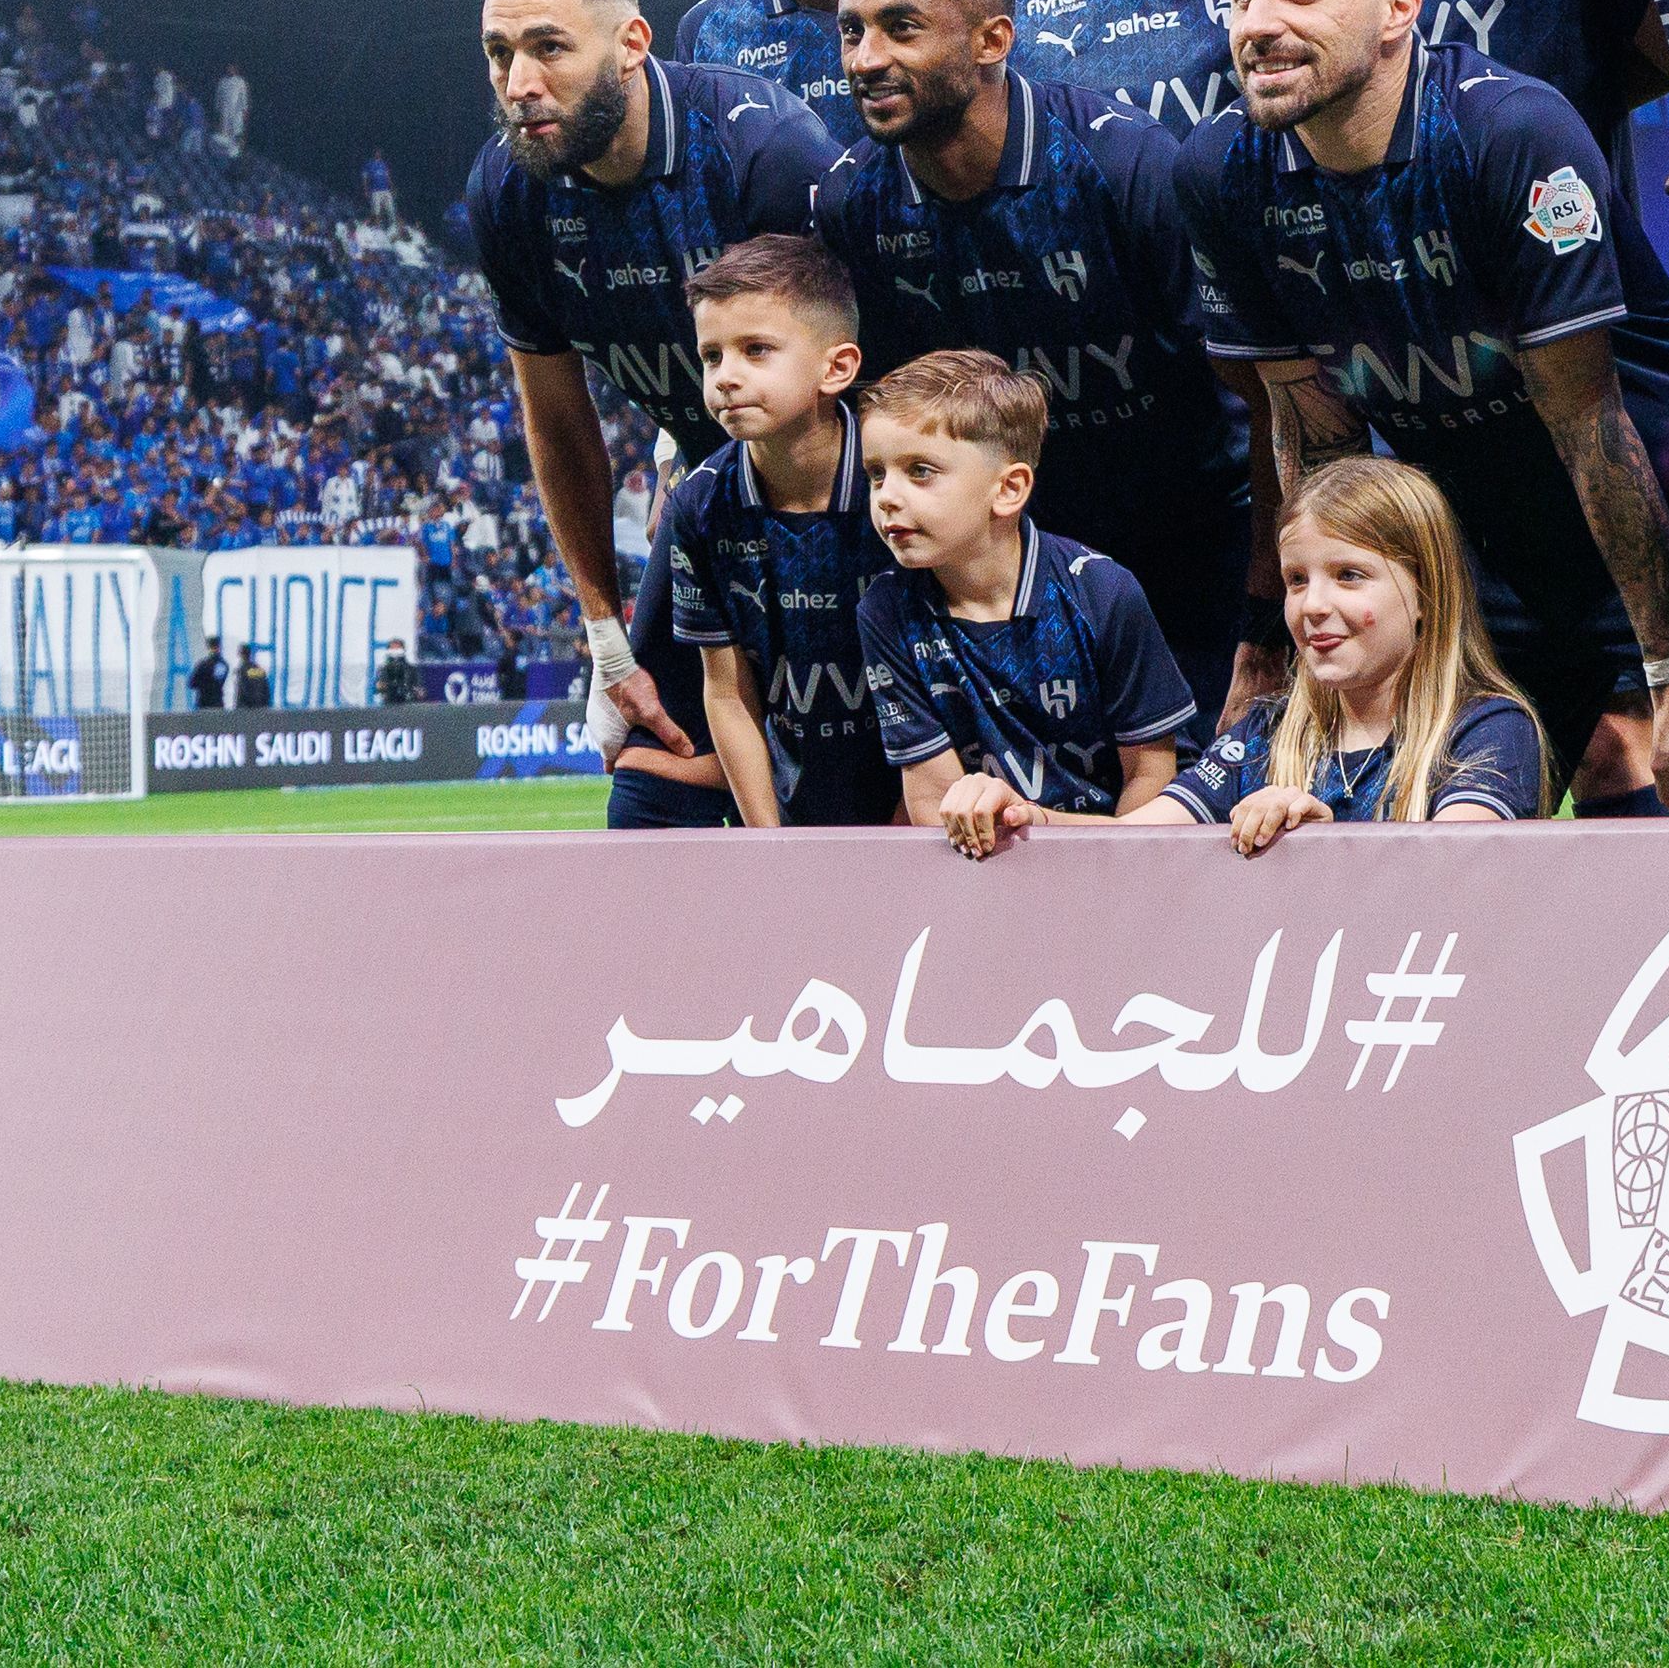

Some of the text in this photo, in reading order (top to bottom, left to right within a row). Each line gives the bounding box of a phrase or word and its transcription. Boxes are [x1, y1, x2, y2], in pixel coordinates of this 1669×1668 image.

[1101, 10, 1181, 44] jahez
[737, 40, 788, 67] flynas
[800, 75, 852, 104] jahe
[1551, 199, 1583, 221] RSL
[606, 262, 671, 291] jahez
[960, 268, 1025, 296] ahez
[717, 538, 769, 555] flnas
[778, 588, 838, 610] ahez
[163, 573, 199, 712] A
[215, 569, 399, 710] CHOICE
[154, 731, 246, 771] ROSHN
[255, 729, 332, 767] SAUDI
[476, 722, 559, 758] ROSHN
[3, 736, 81, 776] LAG
[554, 925, 1467, 1143] #للجماهير
[509, 1180, 1392, 1384] #ForTheFans
